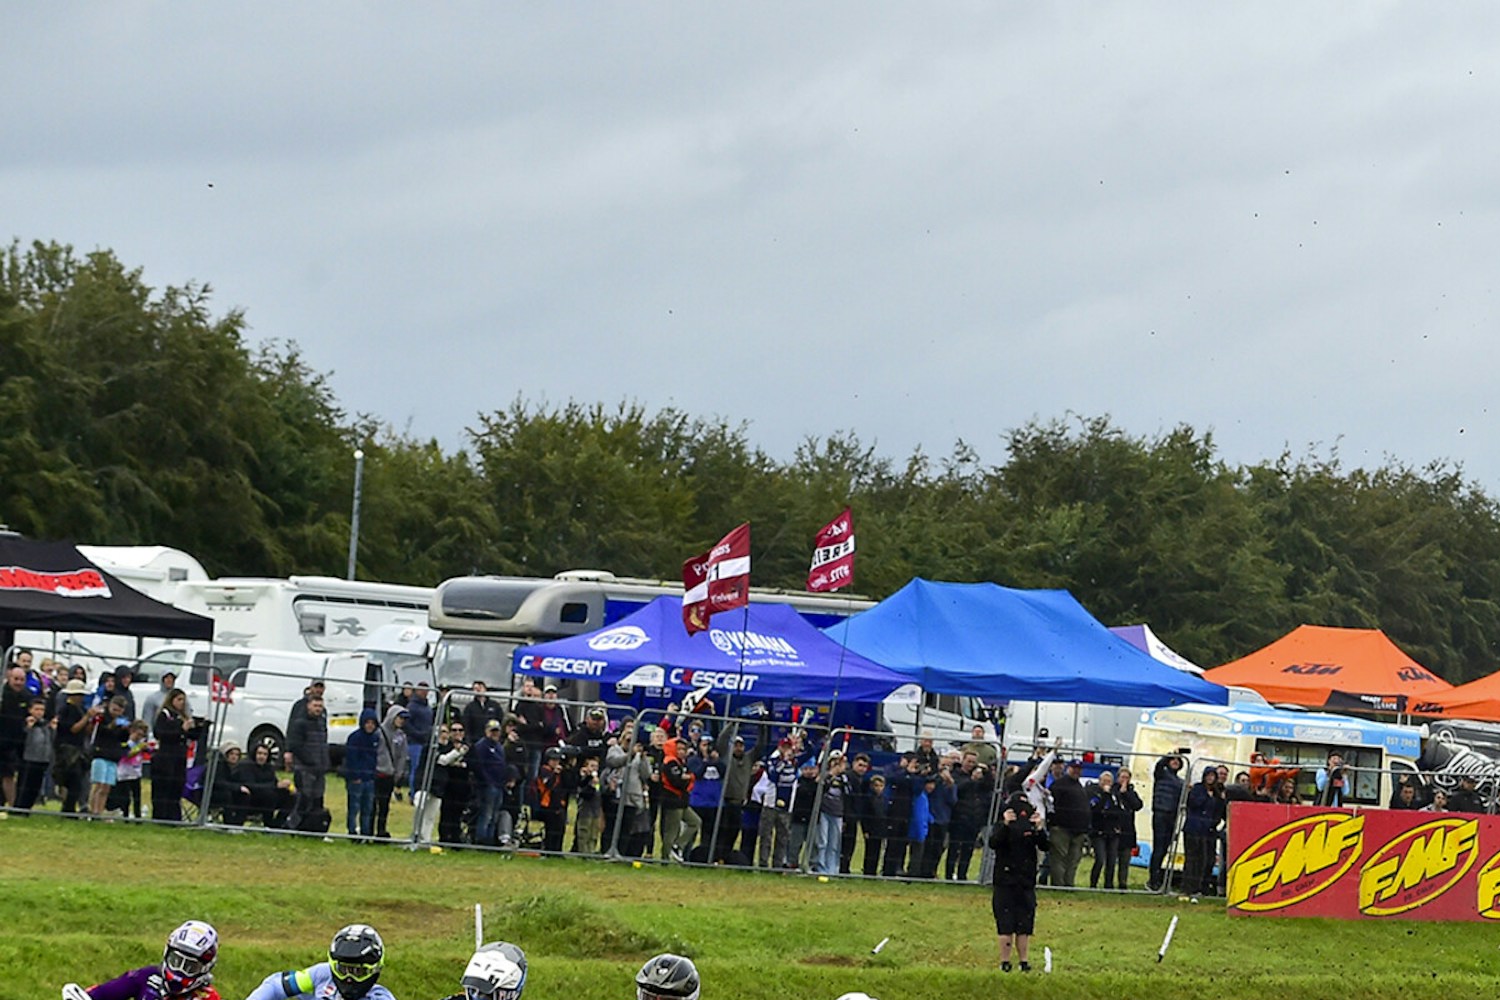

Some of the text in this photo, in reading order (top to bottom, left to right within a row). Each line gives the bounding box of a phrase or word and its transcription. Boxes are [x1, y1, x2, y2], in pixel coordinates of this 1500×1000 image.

[728, 630, 799, 654] YAMAHA
[519, 655, 608, 677] CRESCENT
[1281, 663, 1344, 675] KTM
[1396, 666, 1438, 683] KTM
[1412, 702, 1444, 714] KTM
[1251, 725, 1266, 734] EST
[1268, 727, 1289, 736] 1963
[1386, 737, 1418, 748] EST 1963
[1228, 815, 1365, 909] FMF
[1360, 819, 1479, 914] FMF
